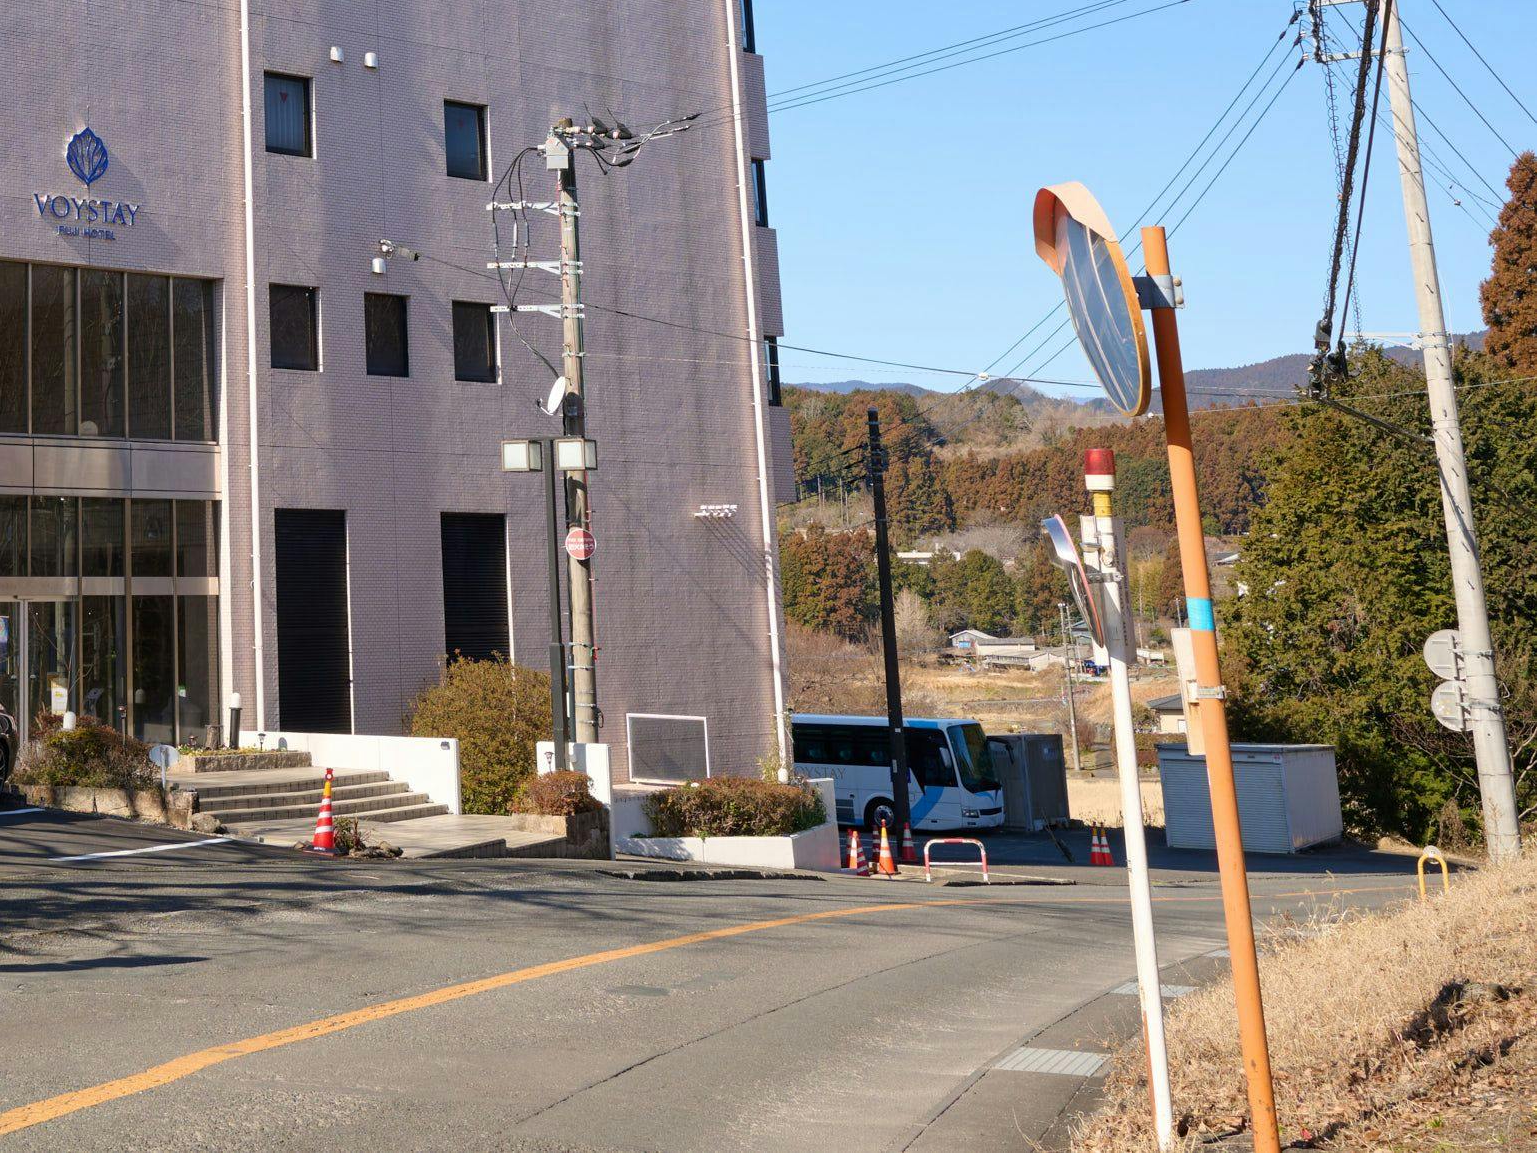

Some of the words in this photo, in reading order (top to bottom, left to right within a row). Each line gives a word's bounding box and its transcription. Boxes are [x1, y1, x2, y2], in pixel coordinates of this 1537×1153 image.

[33, 193, 139, 225] VOYSTAY
[83, 227, 116, 240] HOTEL
[794, 764, 846, 780] OYSTAY
